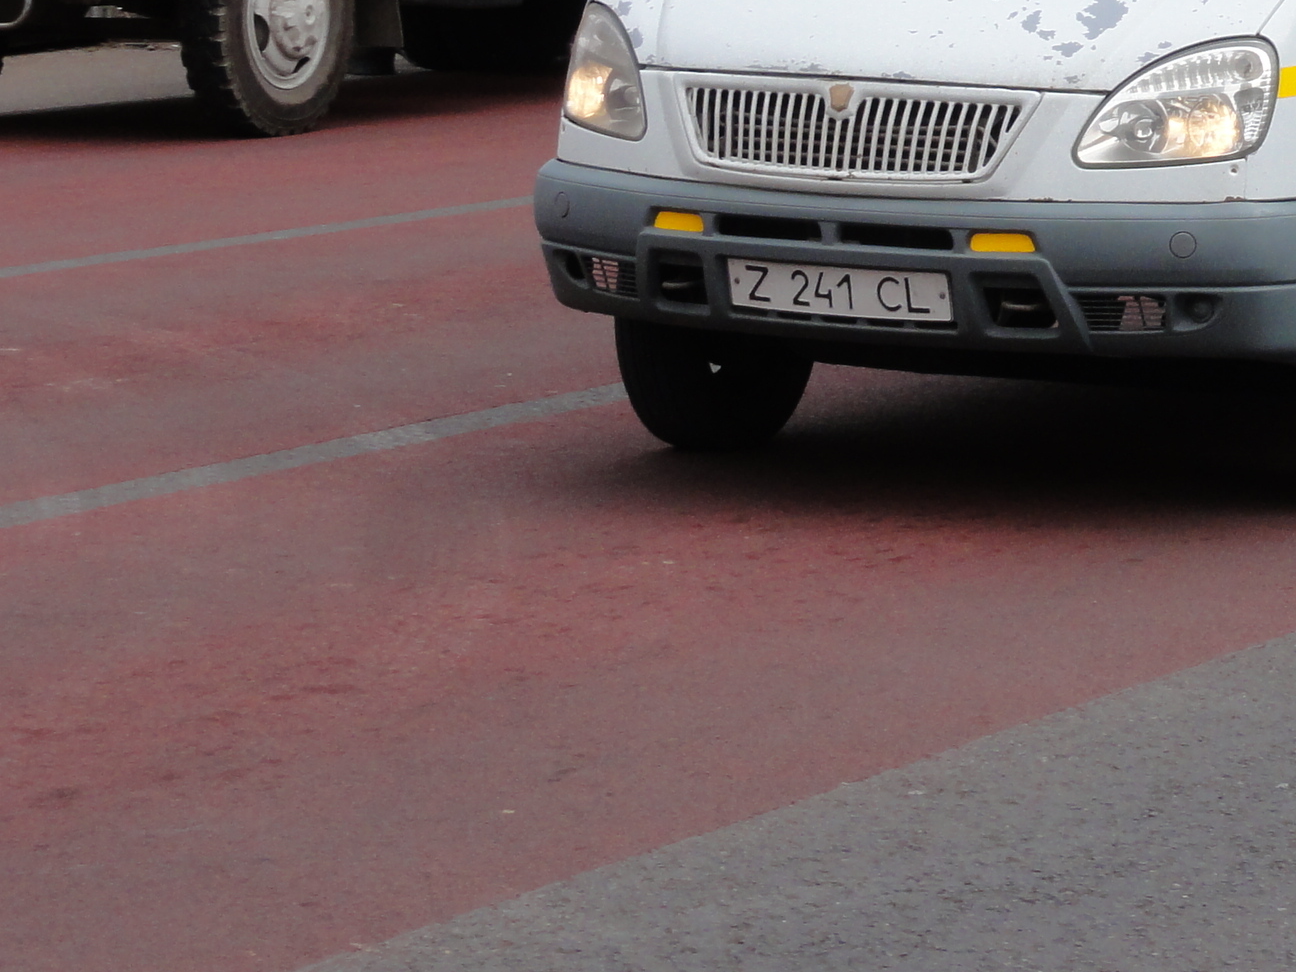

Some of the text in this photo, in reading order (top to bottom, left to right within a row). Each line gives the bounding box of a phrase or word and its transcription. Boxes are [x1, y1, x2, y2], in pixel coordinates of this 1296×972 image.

[745, 265, 931, 314] Z 241 CL
